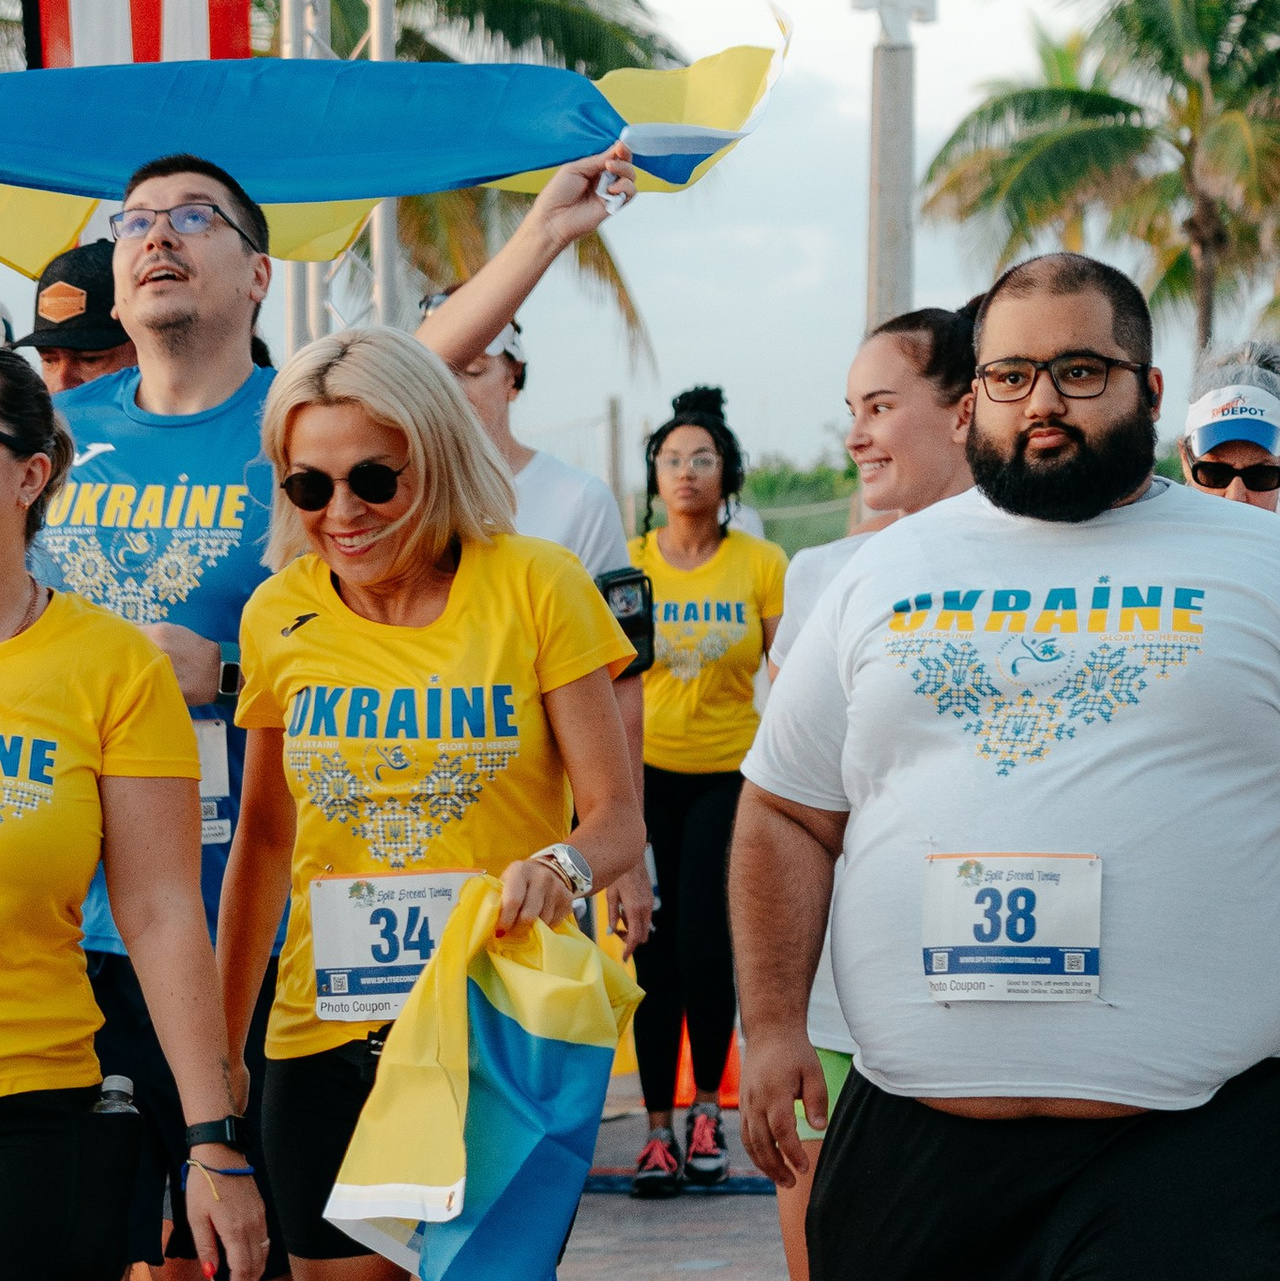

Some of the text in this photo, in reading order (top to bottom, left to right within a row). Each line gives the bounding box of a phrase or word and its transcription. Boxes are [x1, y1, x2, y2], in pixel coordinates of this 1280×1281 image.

[1221, 407, 1266, 417] DEPOT
[46, 481, 250, 530] UKRAINE
[652, 601, 746, 624] RAINE
[888, 585, 1205, 634] UKRAINE
[1099, 633, 1136, 642] GLORY
[1140, 633, 1155, 641] TO
[288, 685, 519, 739] UKRAINE
[438, 742, 469, 751] GLORY
[472, 741, 483, 750] TO
[377, 889, 395, 904] Split
[973, 886, 1037, 943] 38
[369, 906, 436, 964] 34
[950, 979, 986, 993] Coupon
[320, 1001, 350, 1013] Photo
[352, 1000, 391, 1014] Coupon
